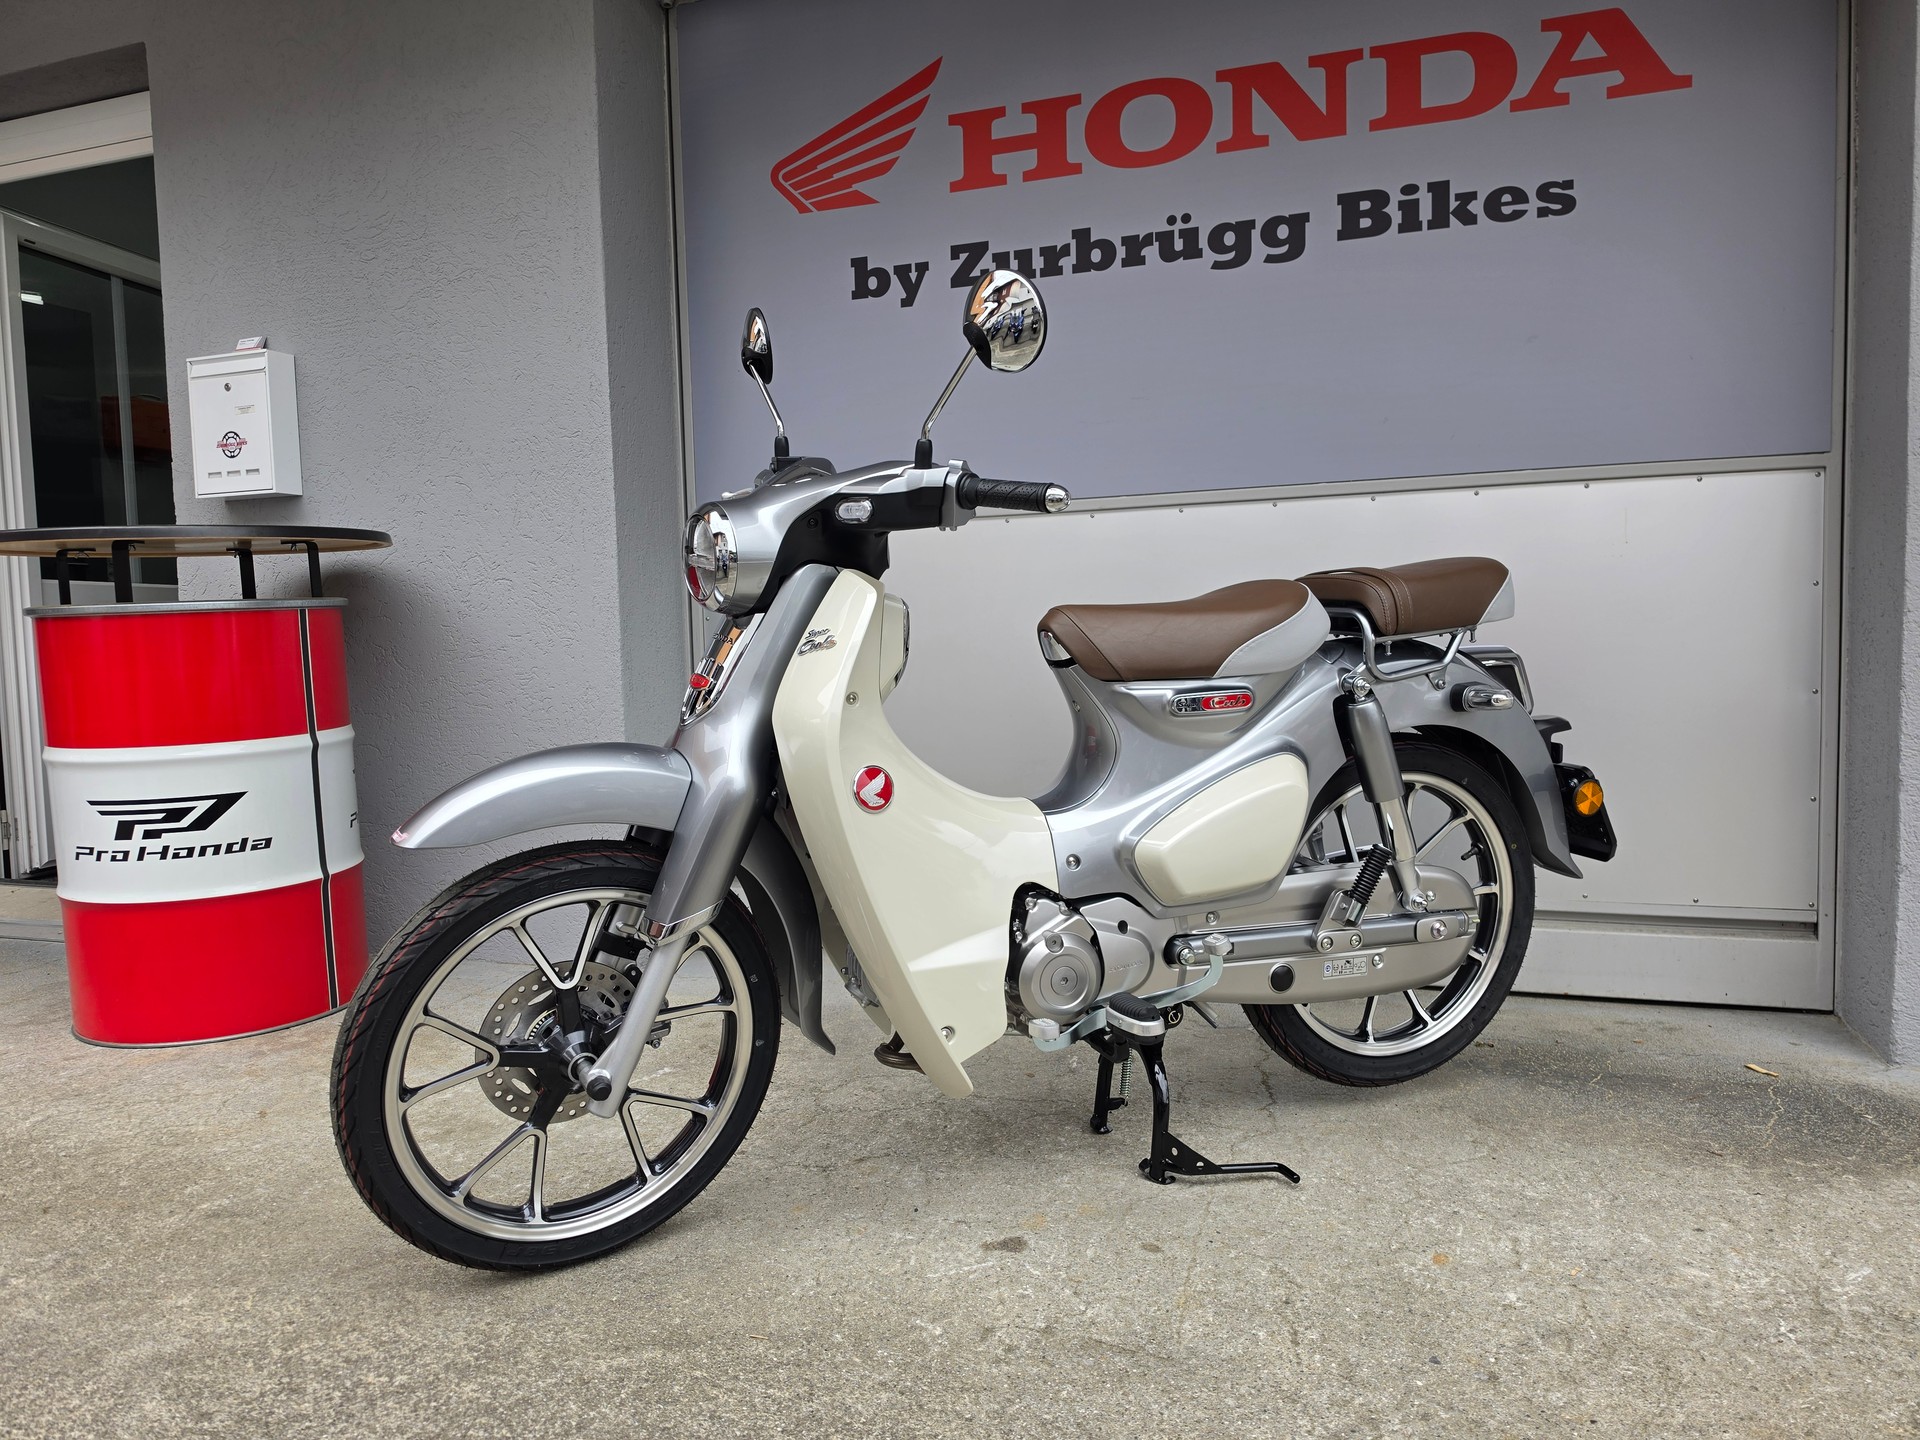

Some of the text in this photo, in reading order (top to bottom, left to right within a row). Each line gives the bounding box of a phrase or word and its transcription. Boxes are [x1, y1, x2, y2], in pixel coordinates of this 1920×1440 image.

[948, 8, 1692, 192] HONDA
[850, 179, 1577, 308] by Zurbrügg Bikes
[1210, 695, 1246, 709] Cub
[75, 836, 273, 862] Pro Honda
